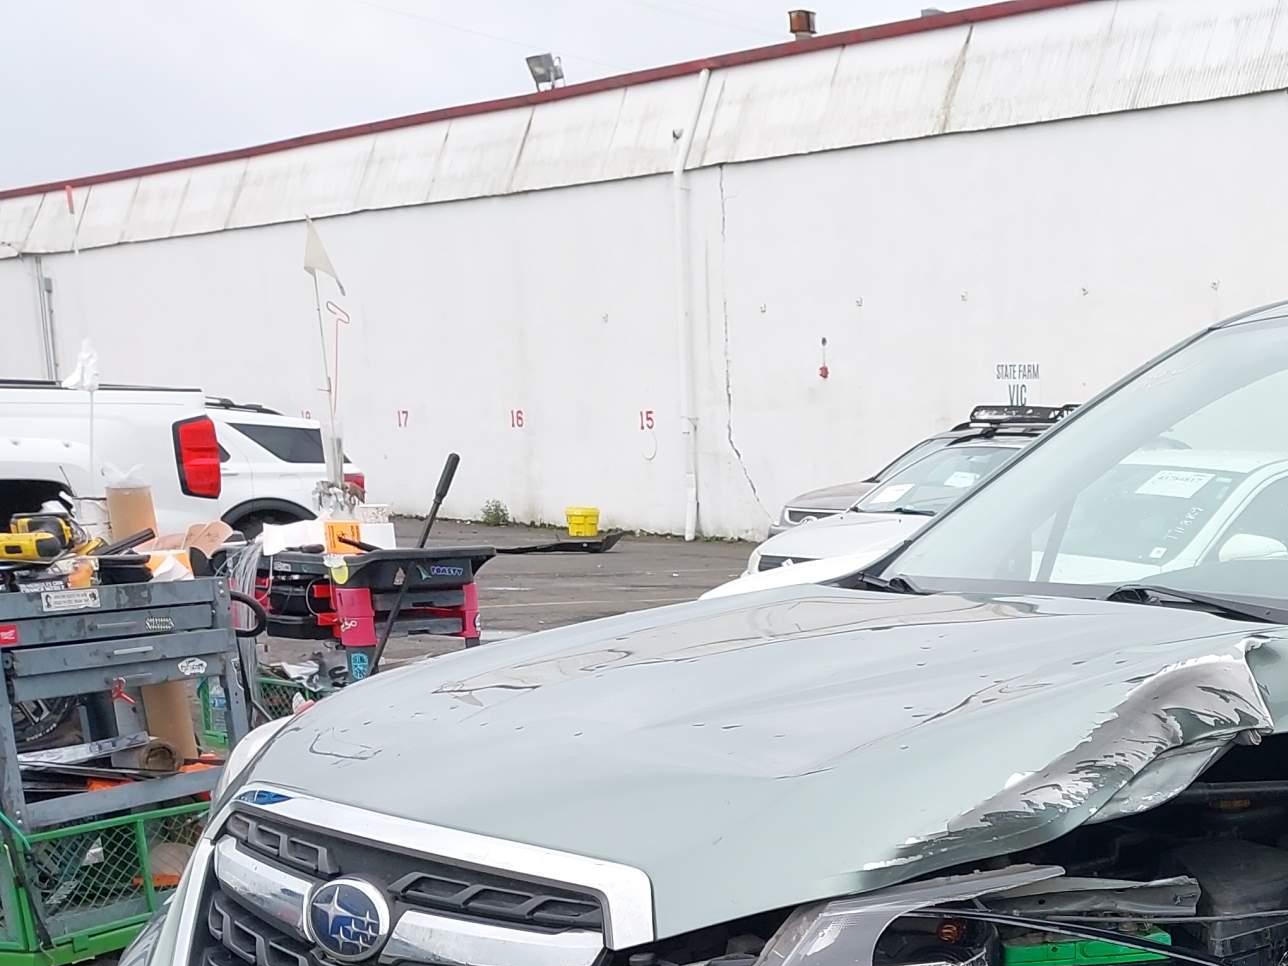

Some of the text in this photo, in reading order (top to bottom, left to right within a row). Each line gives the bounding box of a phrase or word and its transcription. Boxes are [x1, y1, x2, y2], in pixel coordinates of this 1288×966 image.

[996, 364, 1040, 380] STATE FARM
[1008, 384, 1027, 407] VIC
[397, 410, 409, 428] 17
[510, 409, 524, 428] 16
[639, 410, 655, 430] 15
